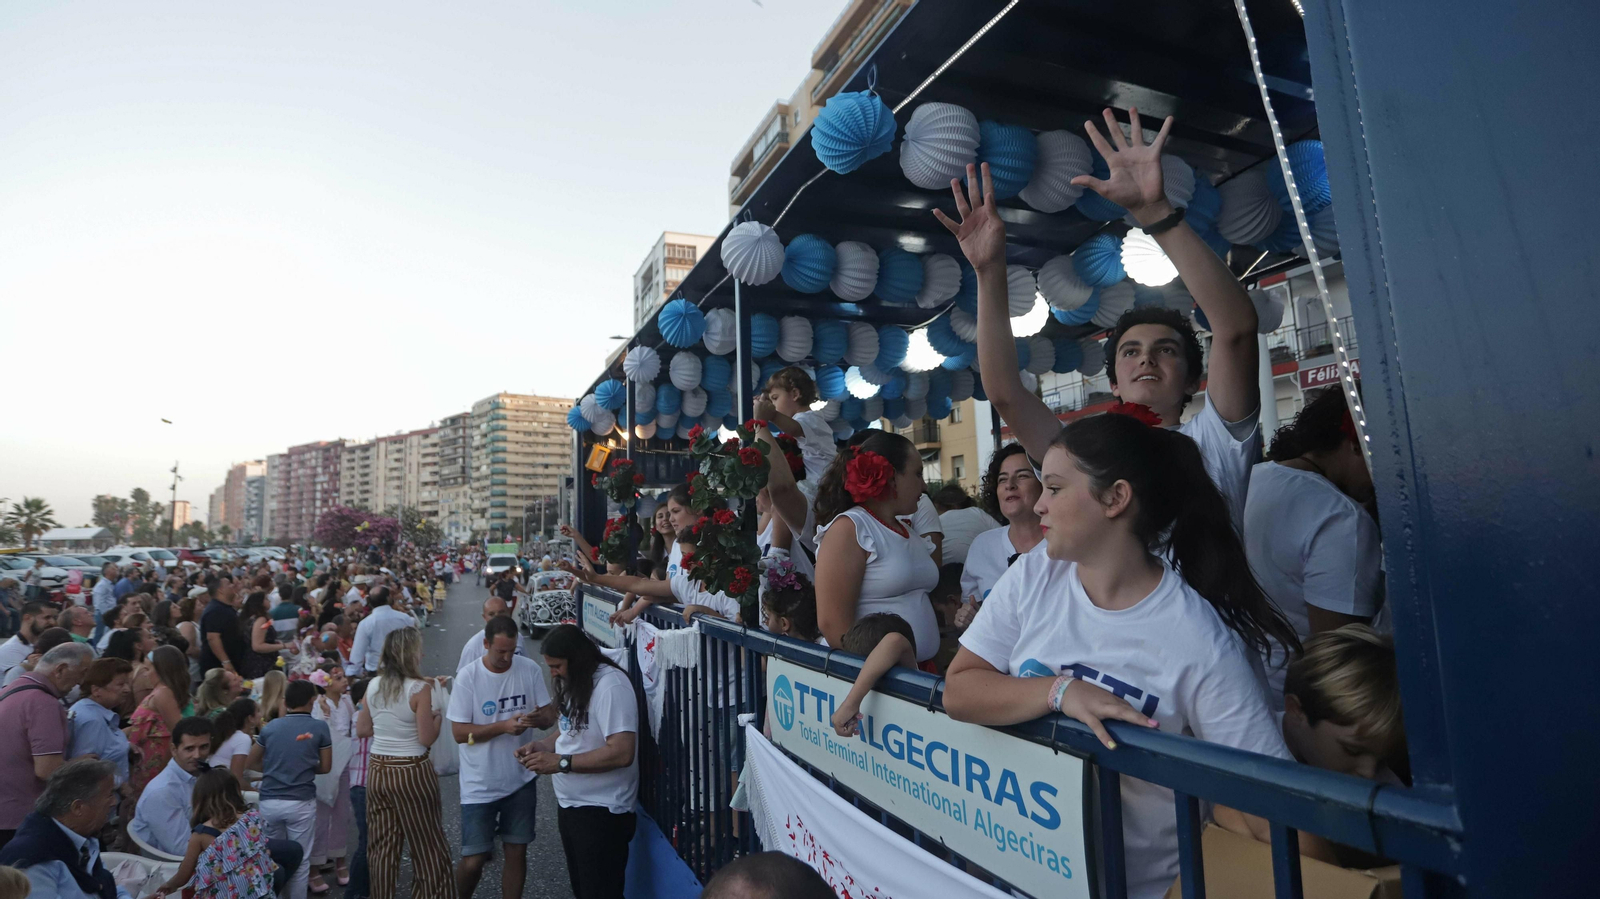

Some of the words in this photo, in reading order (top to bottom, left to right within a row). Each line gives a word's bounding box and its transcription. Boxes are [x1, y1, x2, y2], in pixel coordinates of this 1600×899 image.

[498, 694, 527, 709] TTI
[794, 681, 835, 729] TTI
[856, 714, 1061, 830] LGECIRAS
[799, 720, 821, 747] Total
[822, 732, 869, 773] Terminal
[871, 755, 968, 826] International
[974, 808, 1073, 879] Algeciras
